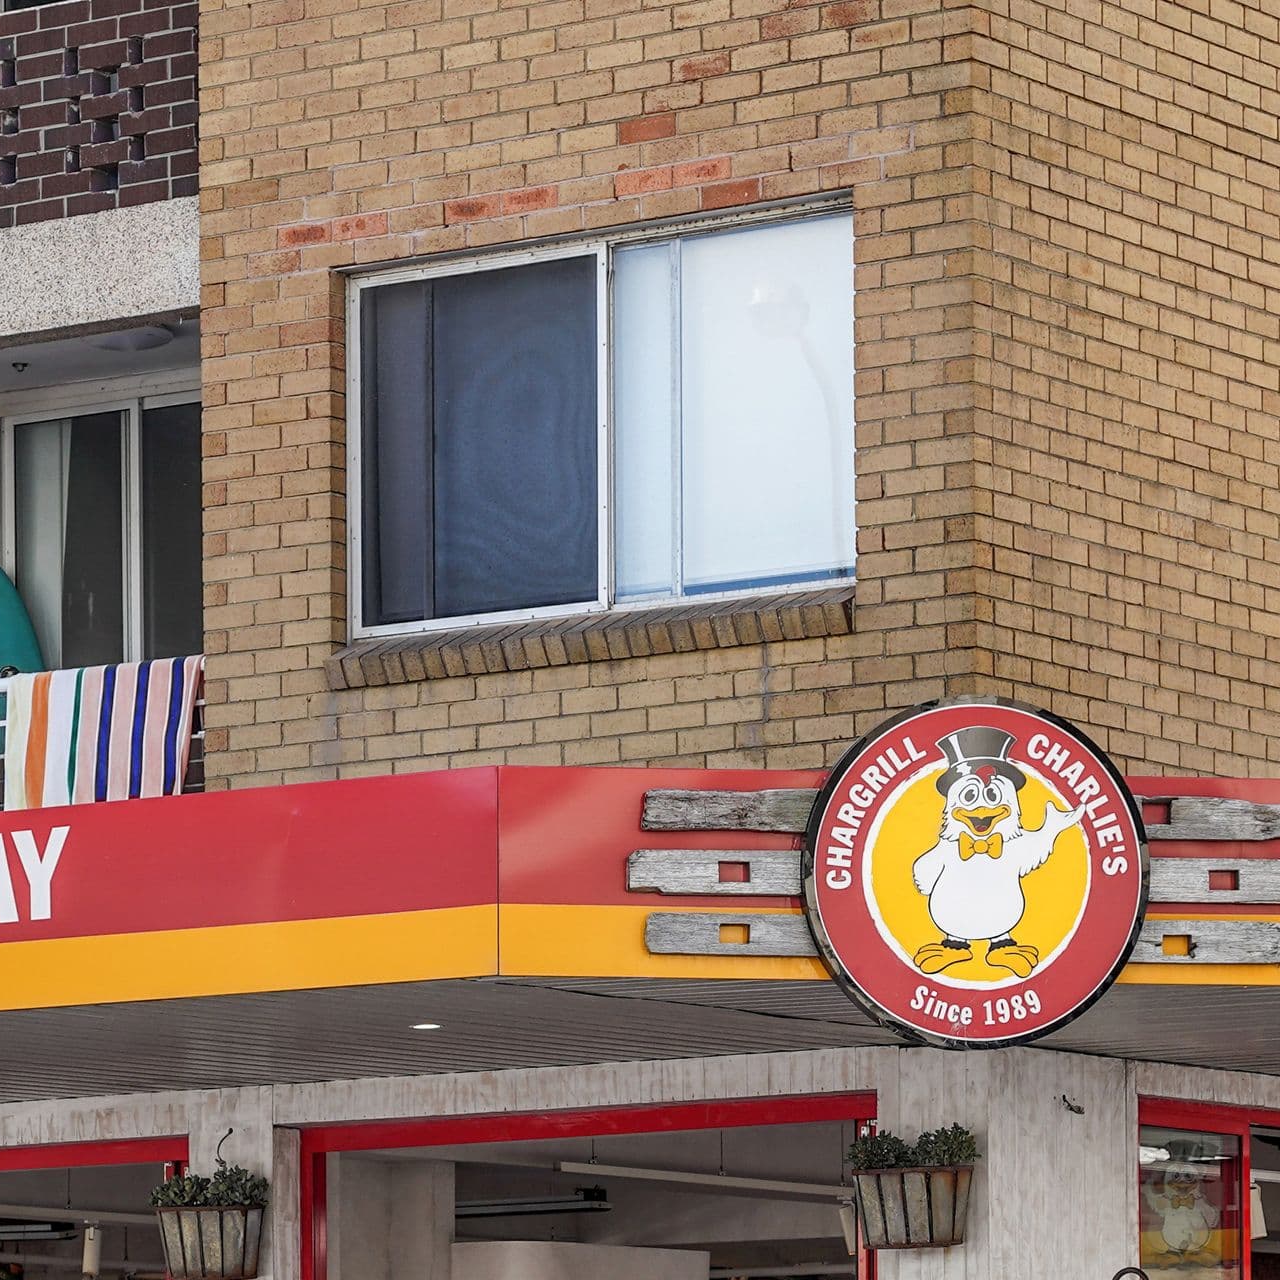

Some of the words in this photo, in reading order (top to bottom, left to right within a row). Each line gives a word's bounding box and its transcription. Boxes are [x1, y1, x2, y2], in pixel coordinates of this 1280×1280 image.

[825, 736, 928, 890] CHARGRILL
[1026, 733, 1129, 876] CHARLIE'S
[909, 985, 973, 1025] Since
[982, 989, 1042, 1026] 1989
